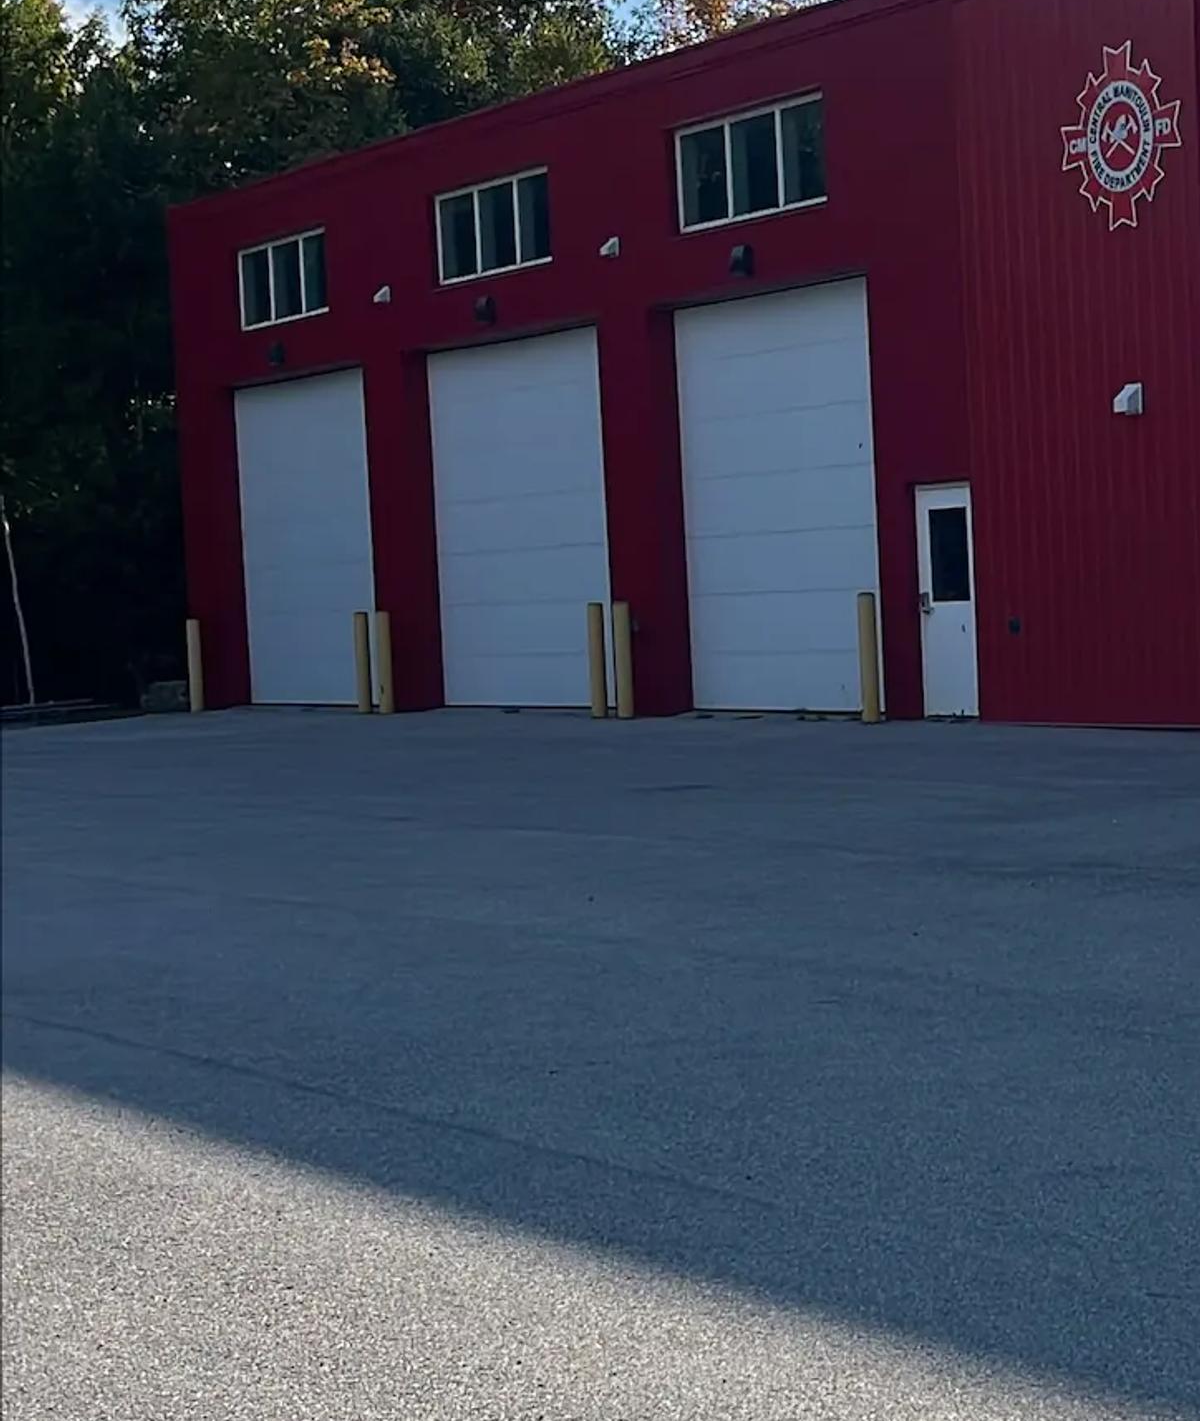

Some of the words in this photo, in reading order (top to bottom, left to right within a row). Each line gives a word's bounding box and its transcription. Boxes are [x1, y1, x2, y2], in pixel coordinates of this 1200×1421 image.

[1088, 92, 1114, 144] CENTRAL
[1113, 84, 1151, 133] MANITOULIN
[1091, 149, 1105, 181] FIRE
[1104, 141, 1151, 190] DEPARTMENT
